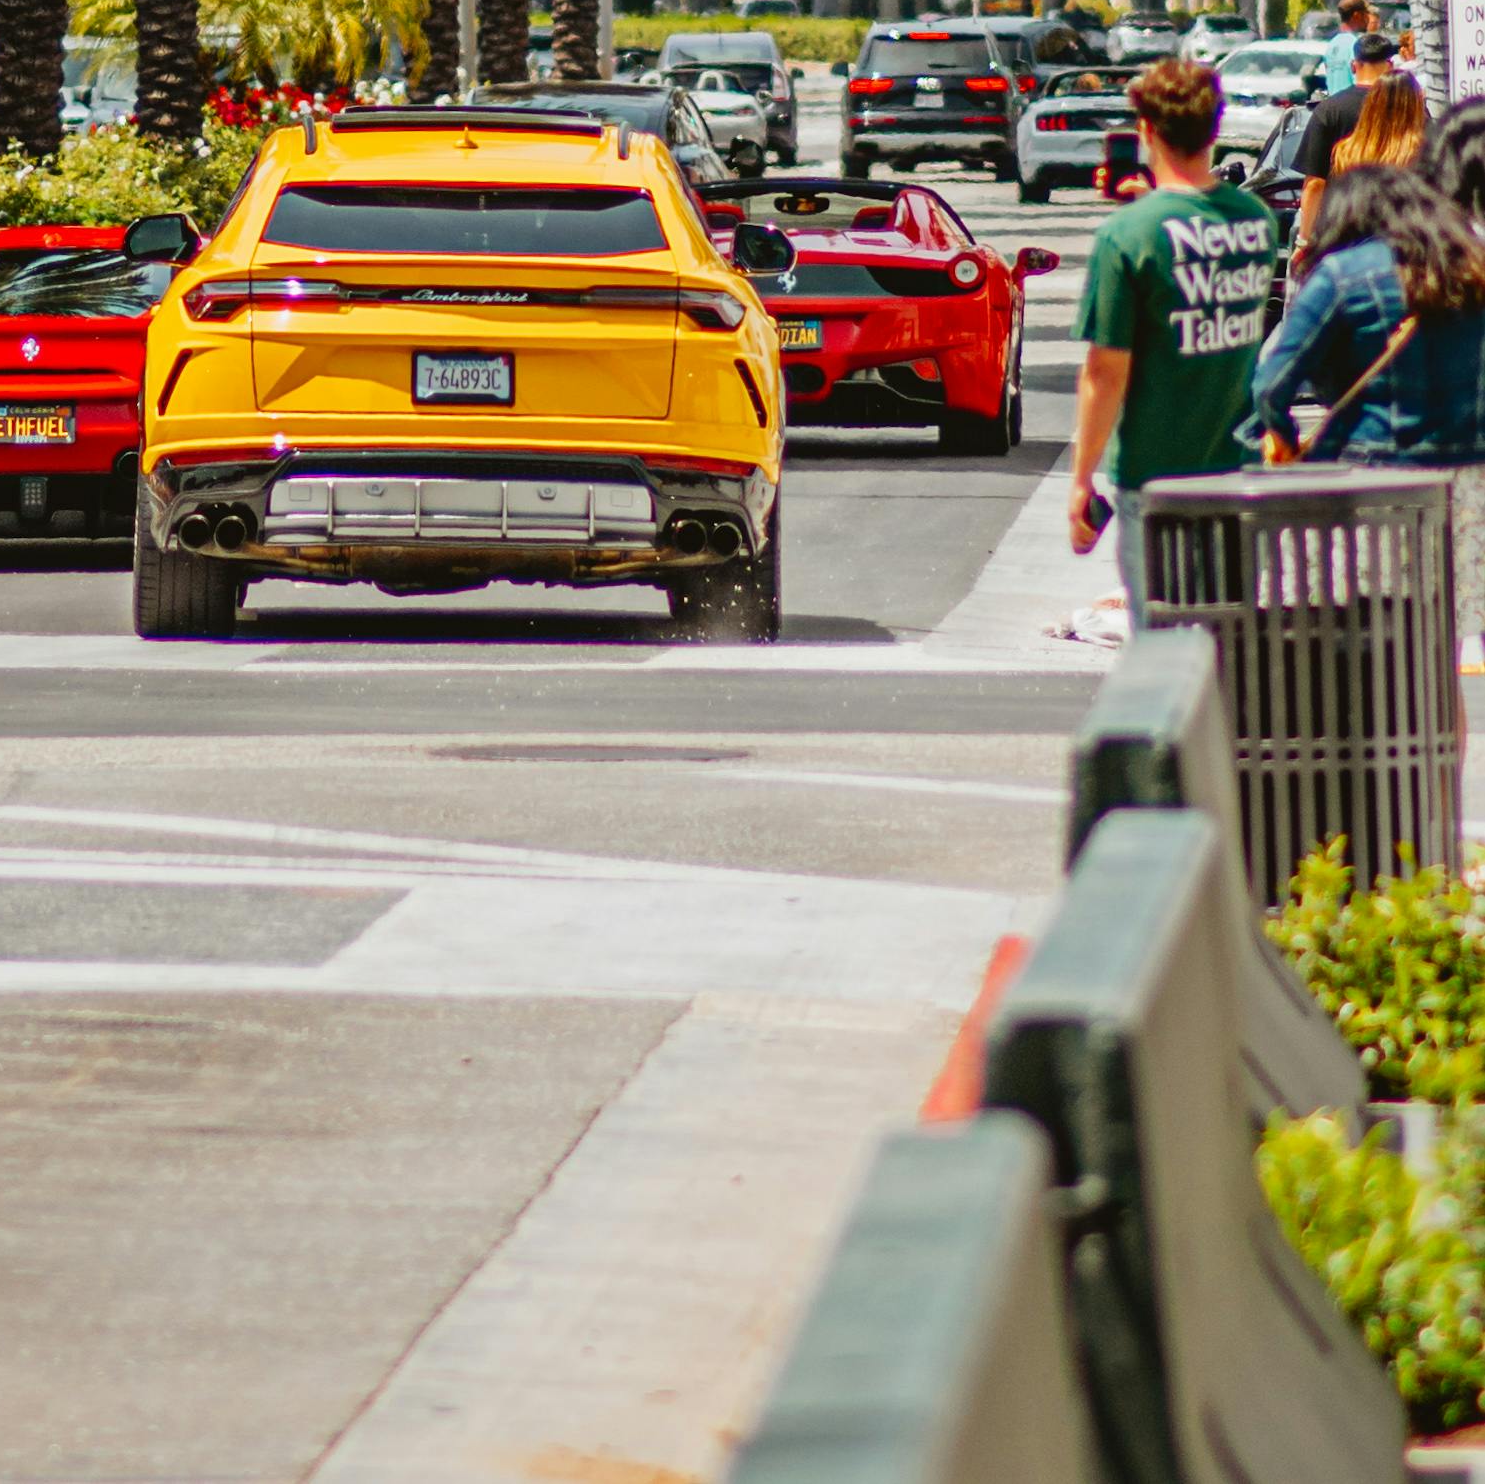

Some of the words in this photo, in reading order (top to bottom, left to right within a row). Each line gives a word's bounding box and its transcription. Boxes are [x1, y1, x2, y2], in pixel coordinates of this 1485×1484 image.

[1162, 215, 1269, 263] Never
[401, 289, 528, 304] Lamborghini
[1172, 260, 1272, 305] Waste
[778, 328, 818, 345] DIAN
[1169, 306, 1265, 355] Talent
